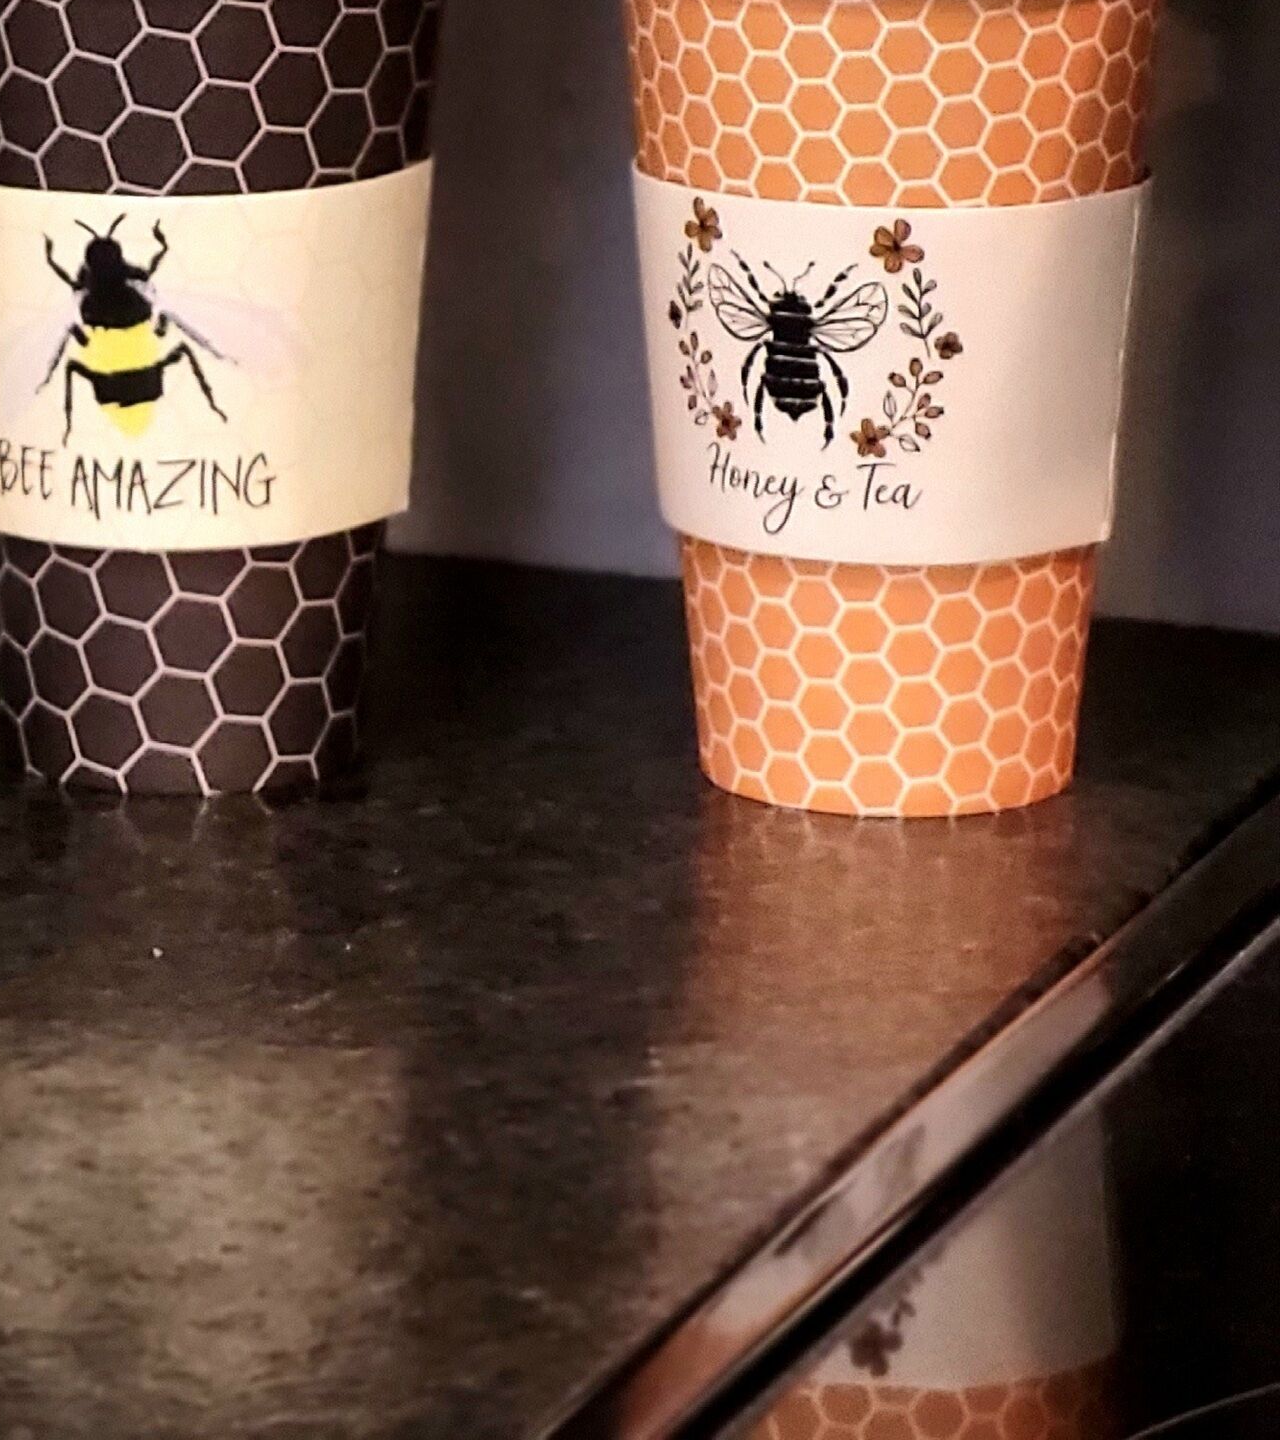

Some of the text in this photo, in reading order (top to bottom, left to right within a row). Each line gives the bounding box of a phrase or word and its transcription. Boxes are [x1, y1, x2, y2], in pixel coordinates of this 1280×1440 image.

[70, 452, 277, 521] AMAZING
[707, 441, 923, 536] Honey & Tea
